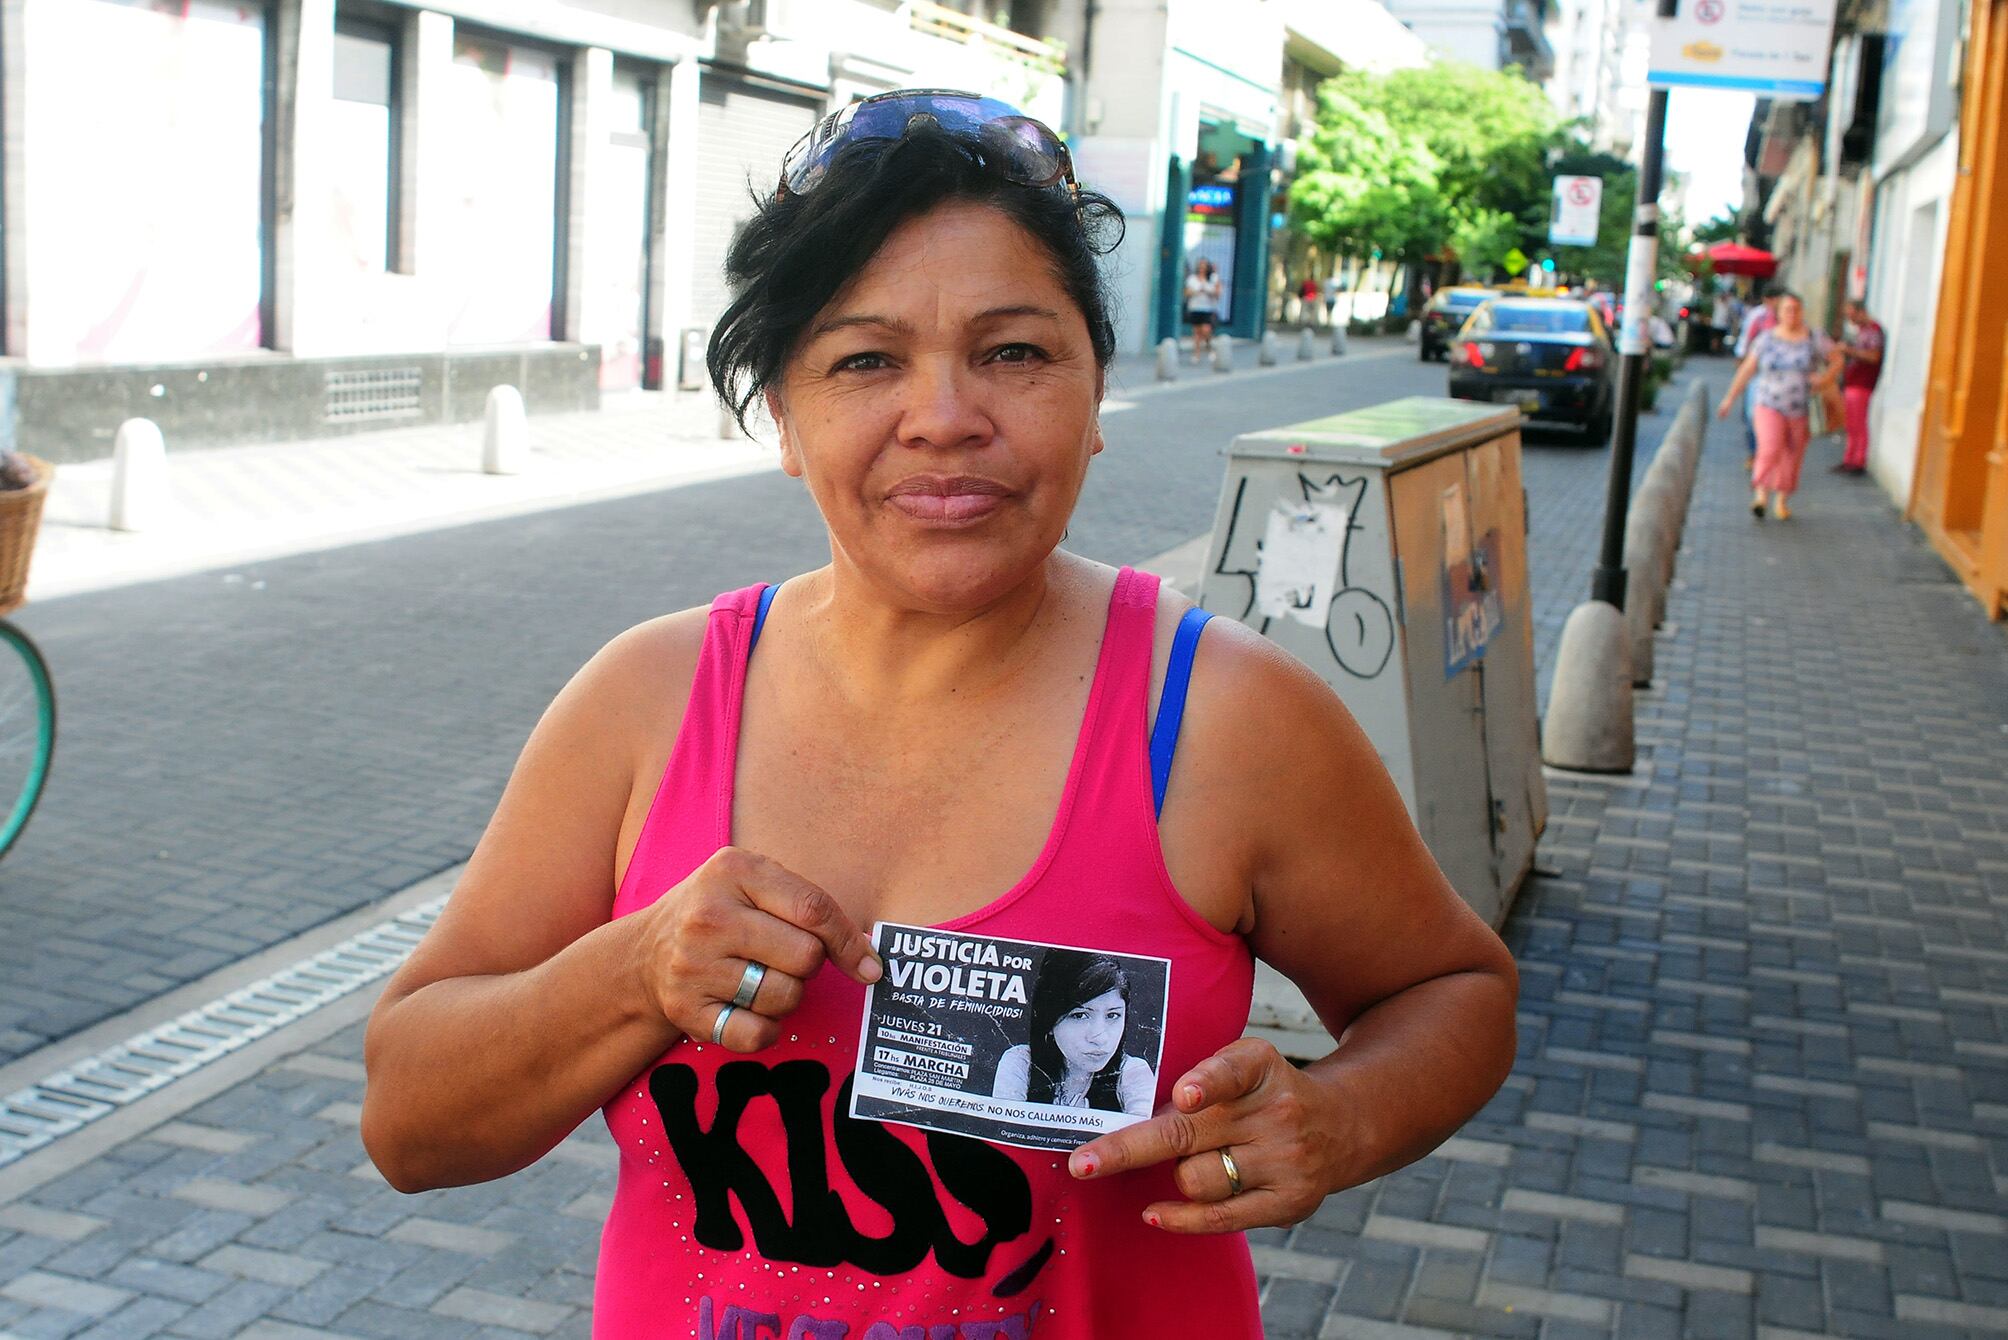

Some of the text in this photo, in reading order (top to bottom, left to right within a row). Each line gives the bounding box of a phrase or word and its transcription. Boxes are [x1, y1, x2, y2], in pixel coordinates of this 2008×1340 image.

[890, 932, 1033, 971] JUSTICIA POR
[889, 958, 1027, 1005] VIOLETA
[891, 991, 1024, 1019] BASTA DE FEMINICIDIOS!
[880, 1014, 943, 1036] JUEVES 21
[900, 1034, 968, 1054] MANIFESTACIÓN
[903, 1055, 964, 1077] MARCHA
[911, 1069, 928, 1078] PLAZA
[910, 1074, 928, 1083] PLAZA
[944, 1081, 961, 1090] MAYO
[918, 1091, 936, 1103] NOS
[938, 1096, 984, 1112] QUEREMOS
[987, 1104, 1003, 1115] NO
[1004, 1108, 1026, 1119] NOS
[1027, 1111, 1077, 1124] CALLAMOS
[1078, 1115, 1104, 1128] MÁS!
